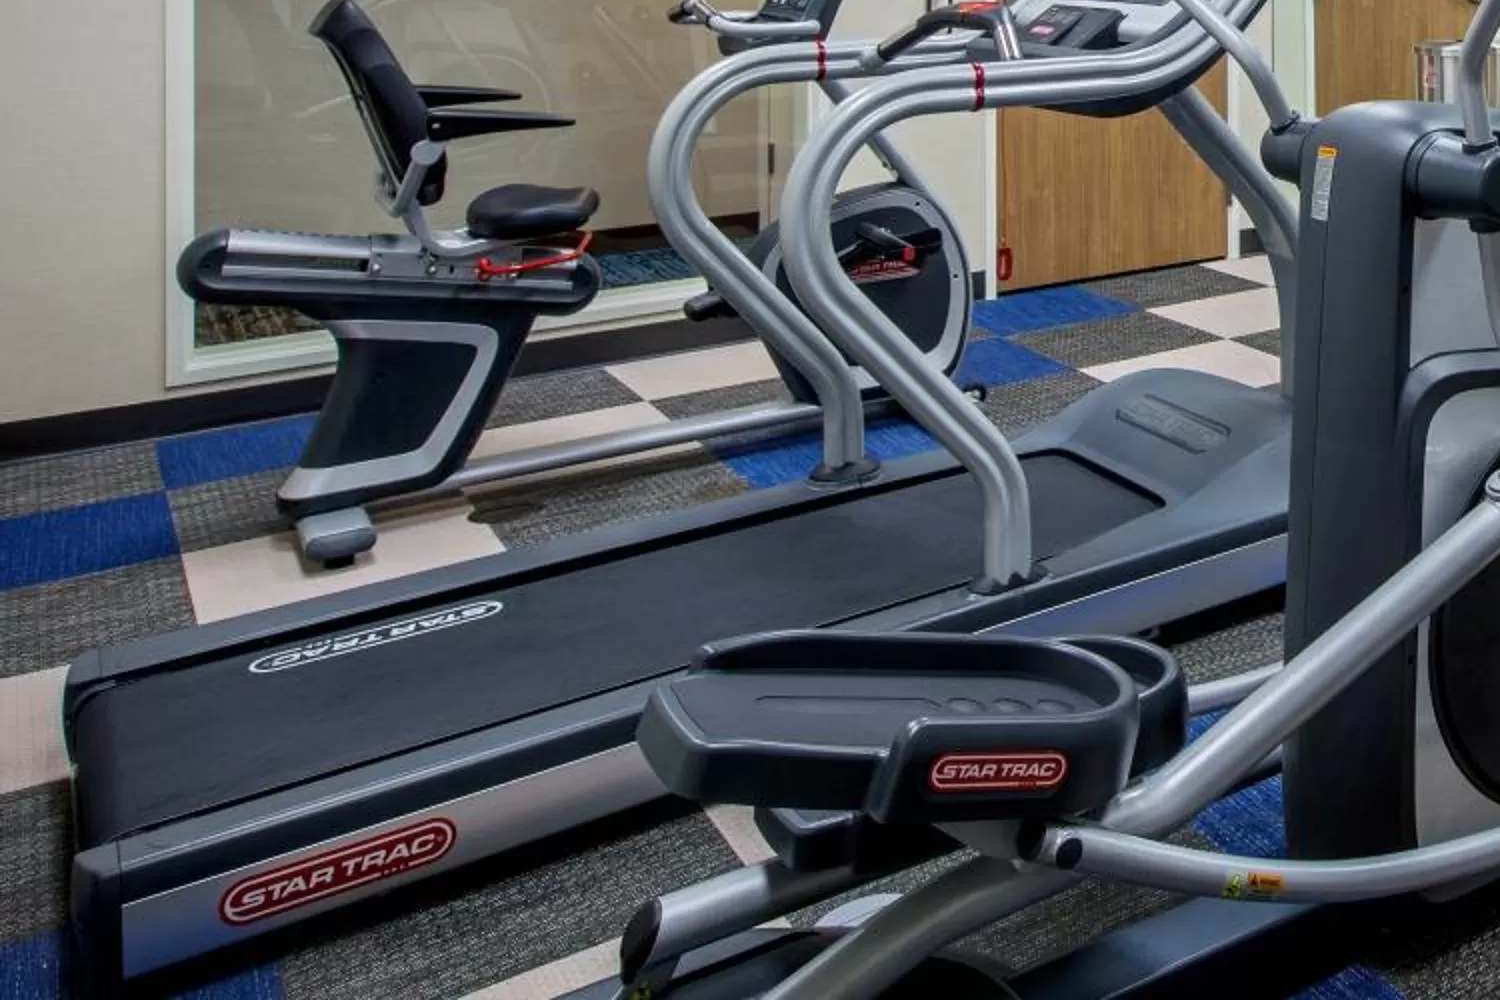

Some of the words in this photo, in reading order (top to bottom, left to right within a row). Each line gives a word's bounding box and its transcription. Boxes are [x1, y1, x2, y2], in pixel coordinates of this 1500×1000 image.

[942, 763, 997, 779] STAR
[1000, 762, 1057, 777] TRAC
[241, 866, 336, 908] STAR
[341, 833, 437, 876] TRAC
